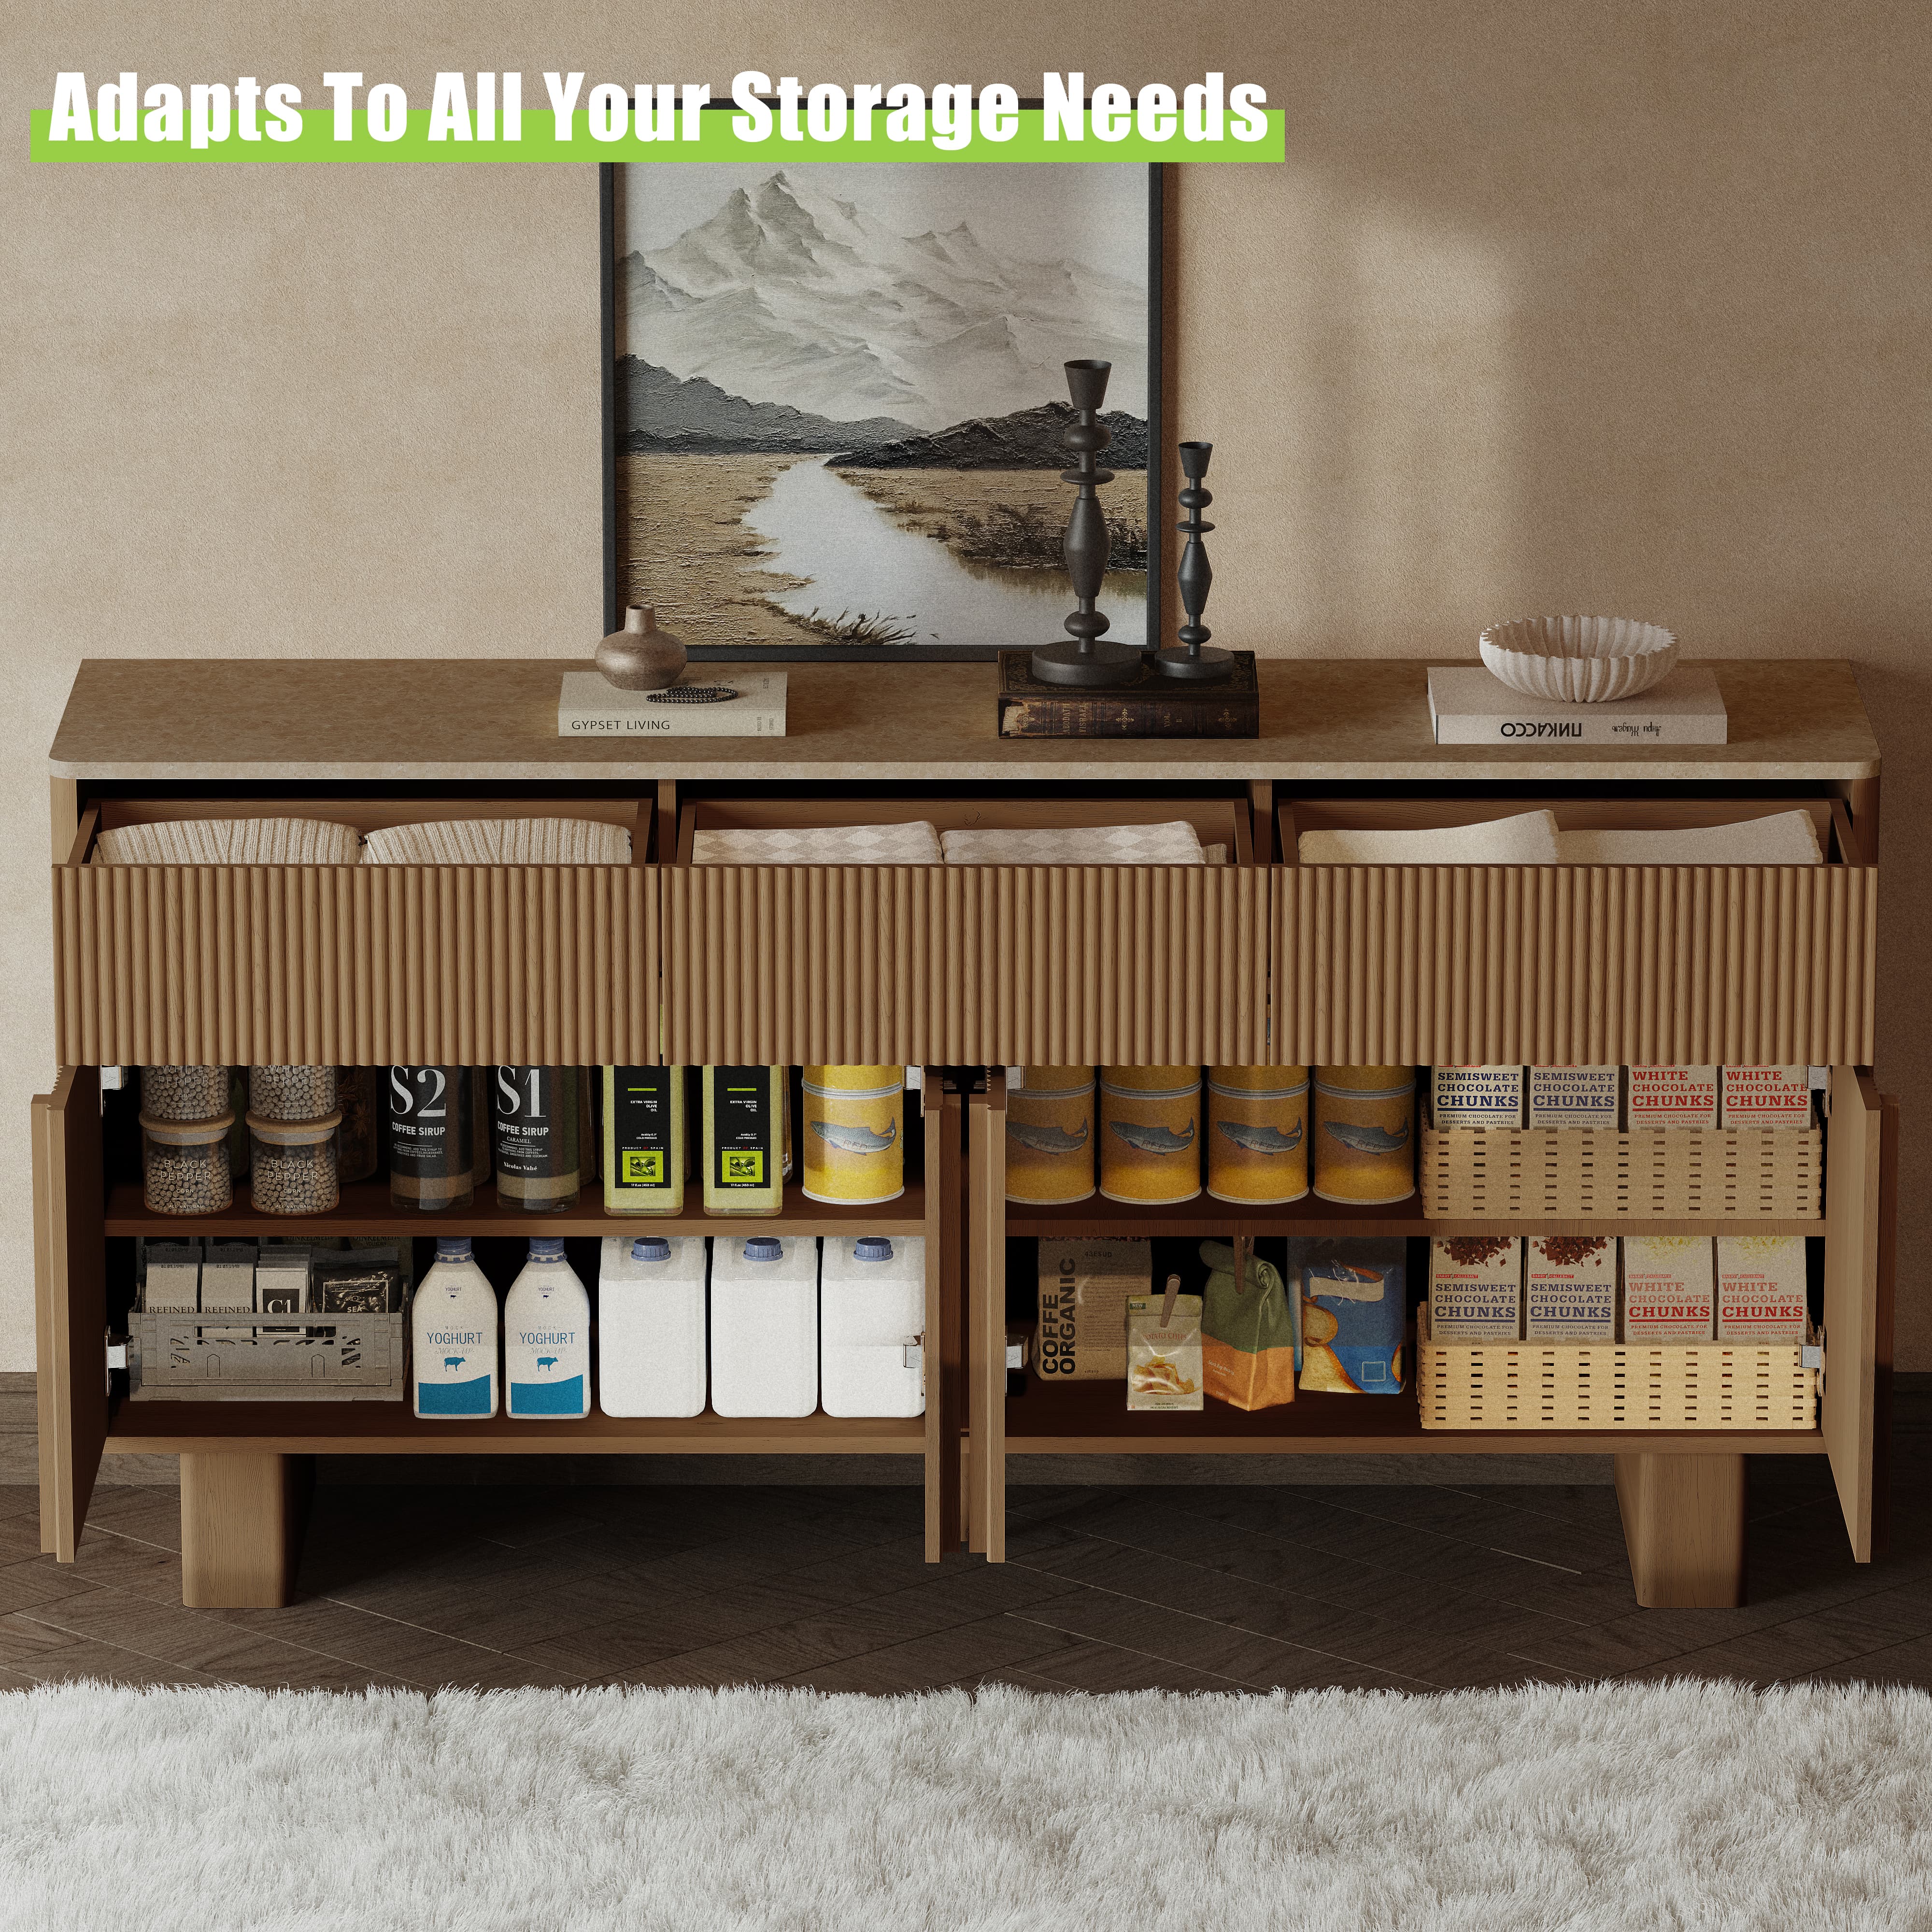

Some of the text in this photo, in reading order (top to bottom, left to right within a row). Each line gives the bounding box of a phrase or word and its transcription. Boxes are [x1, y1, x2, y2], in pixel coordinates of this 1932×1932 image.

[572, 720, 670, 730] GYPSET LIVING
[1501, 723, 1582, 737] ПИКАССО
[1612, 722, 1662, 737] Анри Жидель
[266, 1076, 316, 1085] PEPPER
[1438, 1072, 1519, 1080] SEMISWEET
[1633, 1071, 1688, 1080] WHITE
[1726, 1071, 1781, 1080] WHITE
[158, 1076, 210, 1086] PEPPER
[390, 1065, 446, 1117] S2
[497, 1065, 546, 1117] S1
[1437, 1095, 1518, 1107] CHUNKS
[1534, 1095, 1614, 1107] CHUNKS
[1633, 1095, 1713, 1106] CHUNKS
[1726, 1095, 1807, 1106] CHUNKS
[392, 1122, 445, 1136] COFFEE SIRUP
[497, 1121, 549, 1136] COFFEE SIRUP
[164, 1159, 207, 1169] BLACK
[271, 1159, 313, 1169] BLACK
[503, 1162, 522, 1170] Nicolas
[160, 1171, 212, 1181] PEPPER
[268, 1171, 318, 1181] PEPPER
[1629, 1282, 1684, 1292] WHITE
[1722, 1282, 1777, 1292] WHITE
[1435, 1295, 1515, 1303] CHOCOLATE
[1531, 1295, 1611, 1303] CHOCOLATE
[1629, 1295, 1709, 1303] CHOCOLATE
[267, 1299, 292, 1313] C1
[1060, 1258, 1076, 1374] ORGANIC
[1435, 1306, 1515, 1318] CHUNKS
[1531, 1307, 1611, 1317] CHUNKS
[1629, 1307, 1709, 1317] CHUNKS
[1722, 1306, 1803, 1317] CHUNKS
[426, 1332, 483, 1344] YOGHURT
[519, 1332, 575, 1344] YOGHURT
[1042, 1294, 1058, 1374] COFFE
